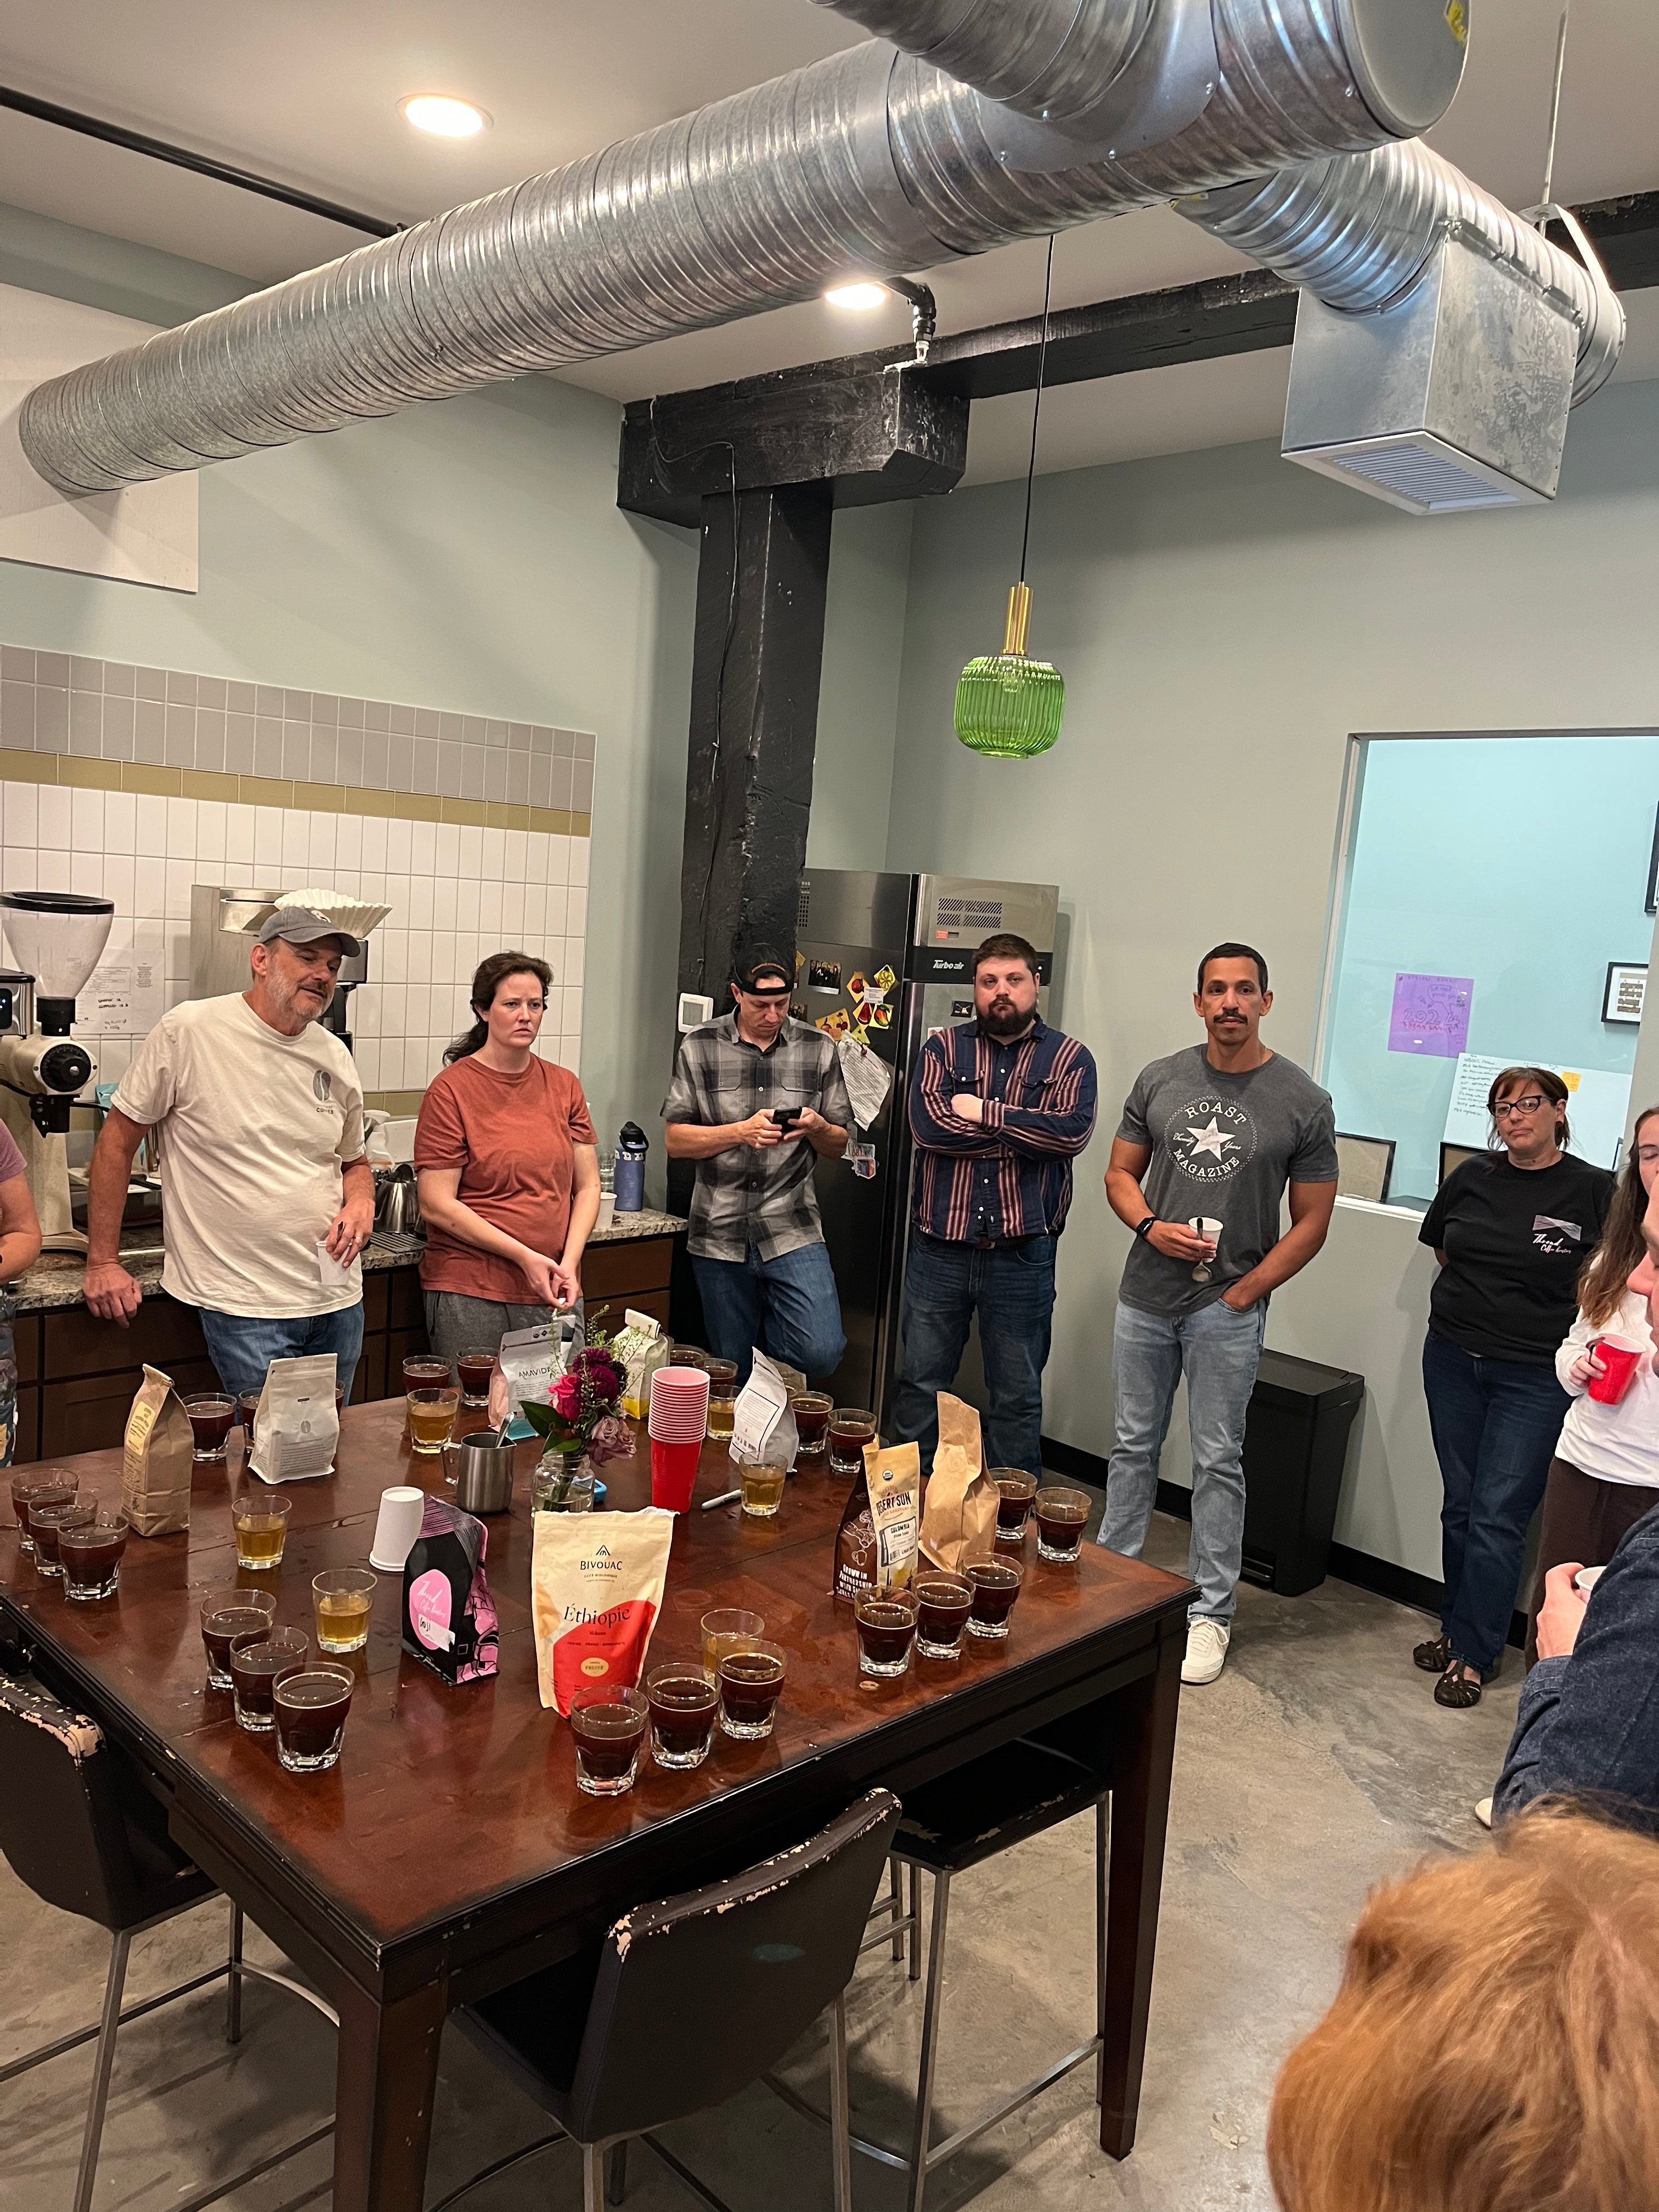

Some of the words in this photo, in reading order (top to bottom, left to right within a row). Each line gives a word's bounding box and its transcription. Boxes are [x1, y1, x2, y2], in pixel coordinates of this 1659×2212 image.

[933, 960, 953, 969] Turbo
[1404, 1009, 1460, 1029] 2024
[1184, 1102, 1246, 1125] ROAST
[1172, 1132, 1195, 1147] Twenty
[1173, 1148, 1240, 1177] MAGAZINE
[896, 1491, 911, 1506] SUN
[580, 1561, 623, 1570] BIVOUAC
[843, 1564, 860, 1578] GROWN
[860, 1572, 867, 1580] IN
[839, 1570, 872, 1588] PARTNERSHIP
[839, 1581, 851, 1592] WITH
[564, 1602, 631, 1629] Éthiopie
